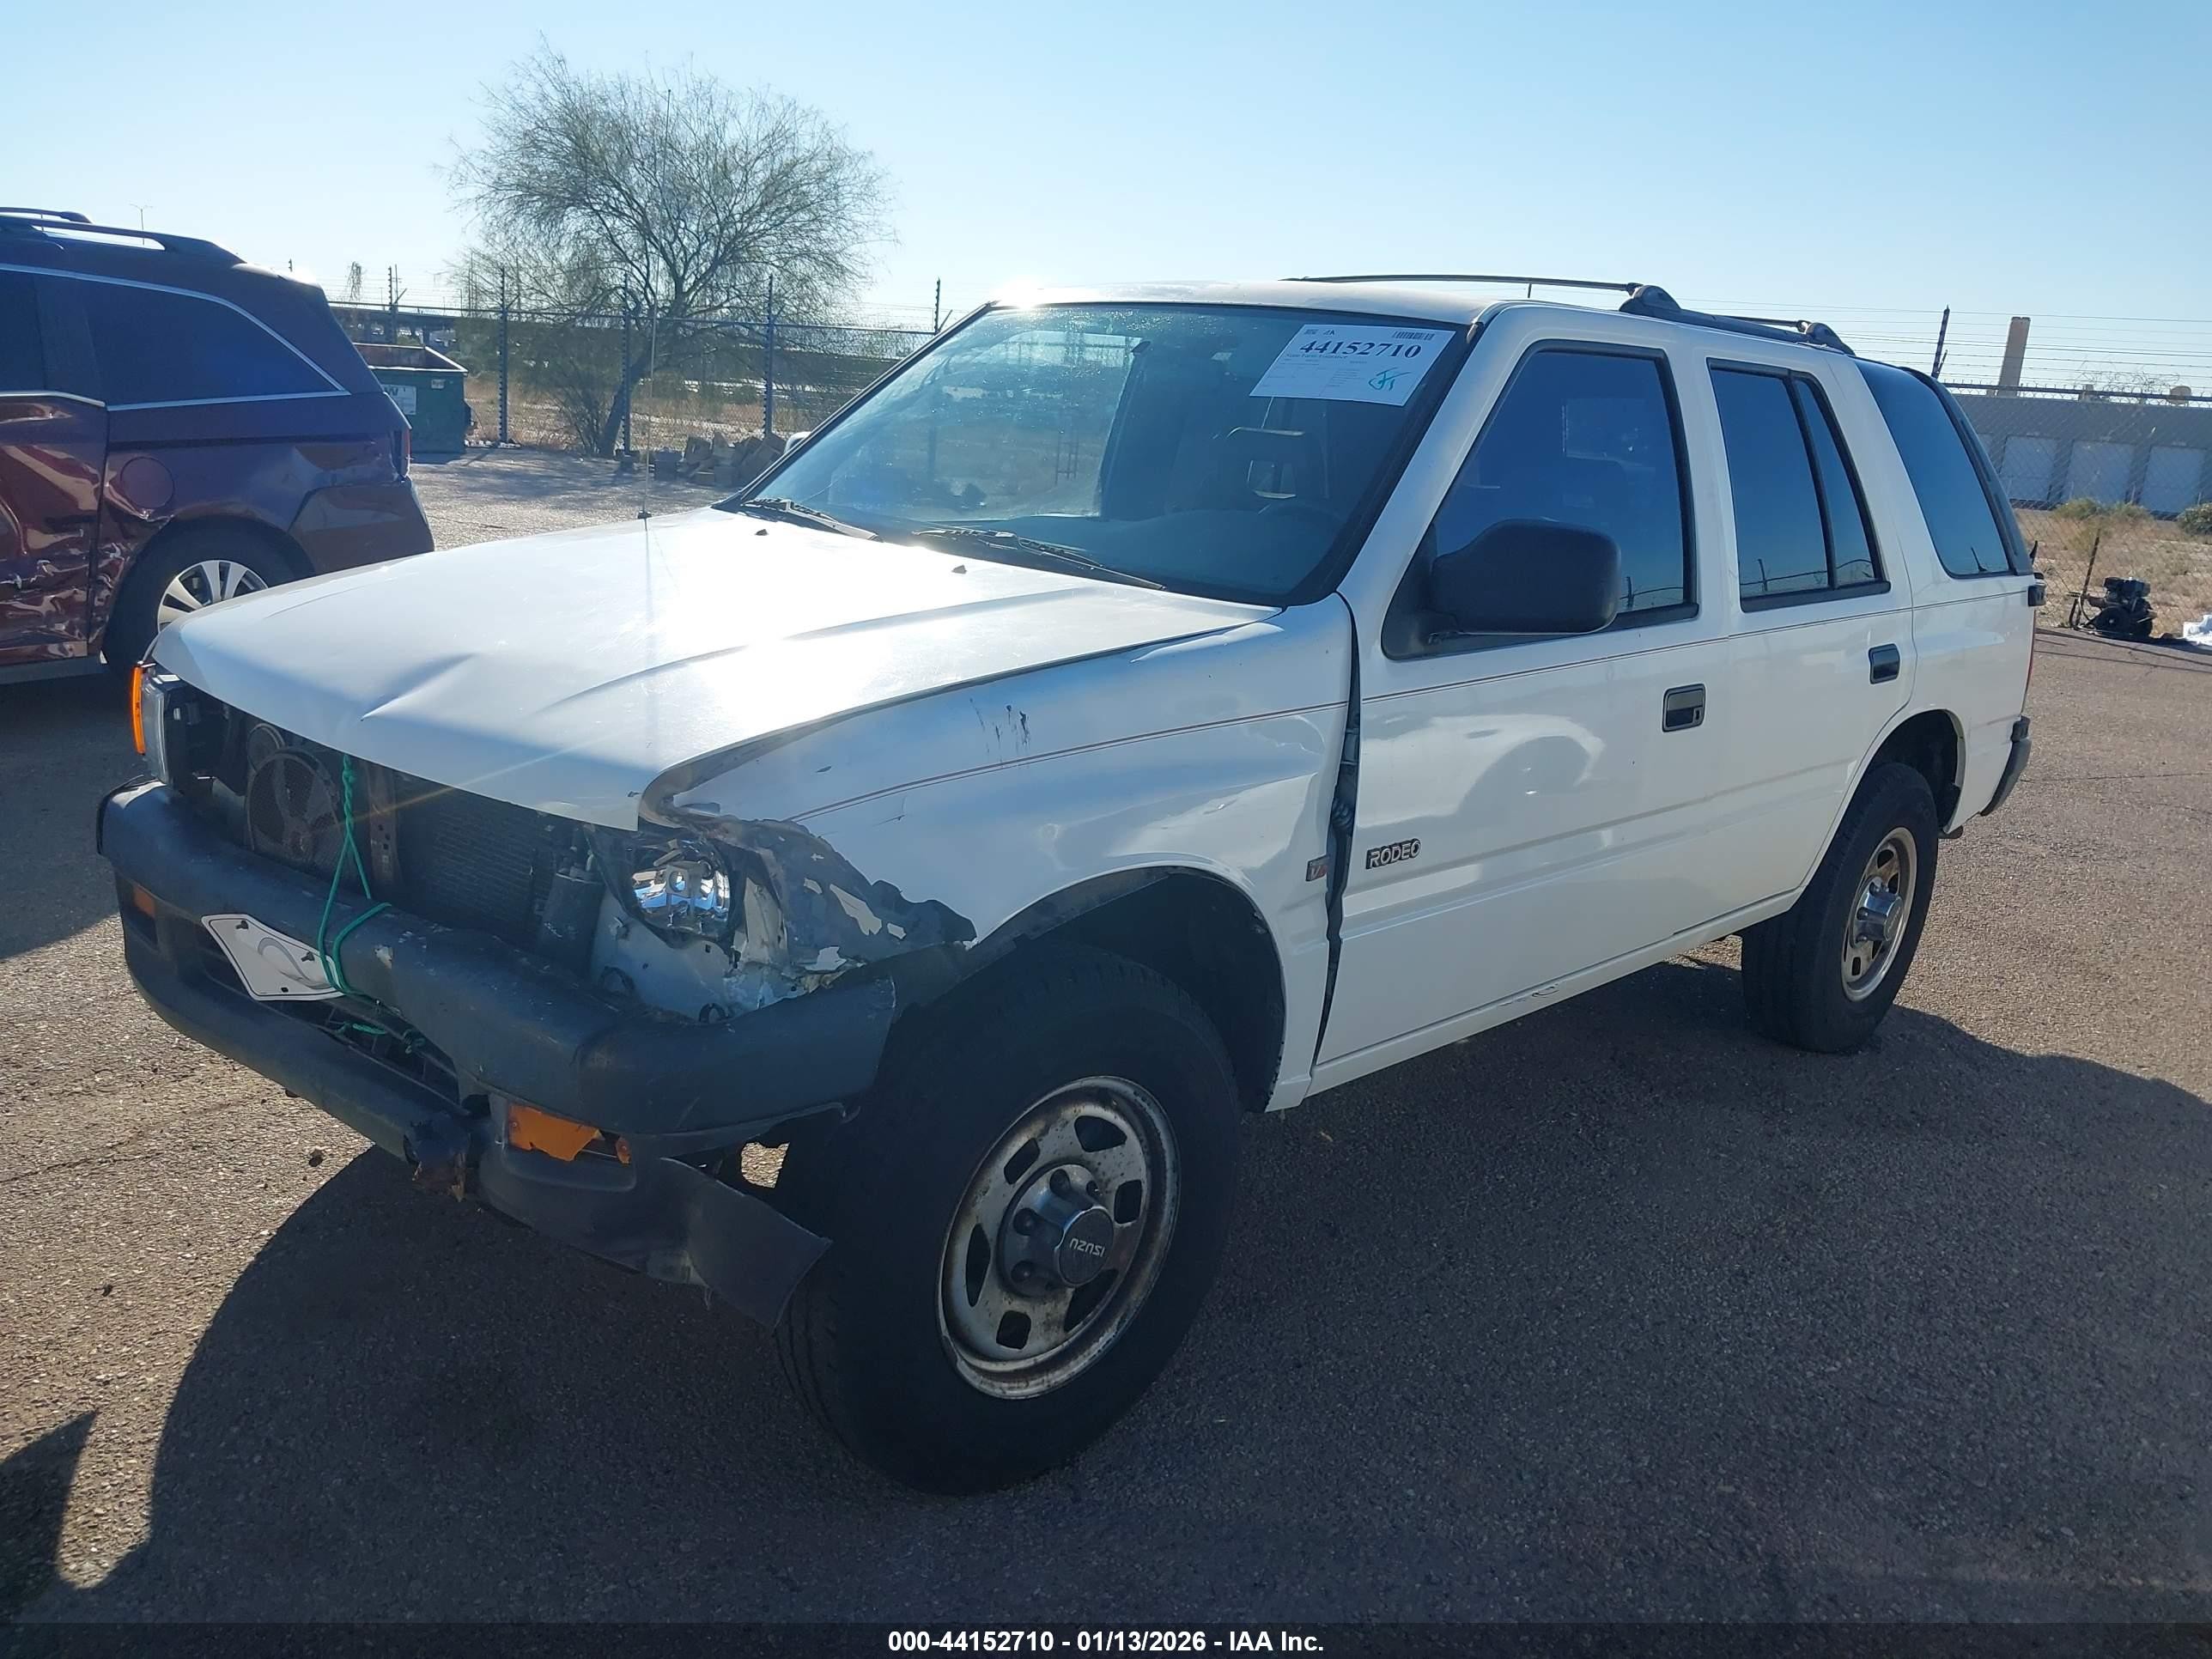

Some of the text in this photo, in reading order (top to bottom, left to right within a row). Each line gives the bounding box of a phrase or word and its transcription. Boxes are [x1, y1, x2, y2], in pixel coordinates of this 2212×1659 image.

[1299, 340, 1422, 358] 44152710
[1368, 839, 1421, 868] RODEO
[1069, 1237, 1106, 1258] ISUZU
